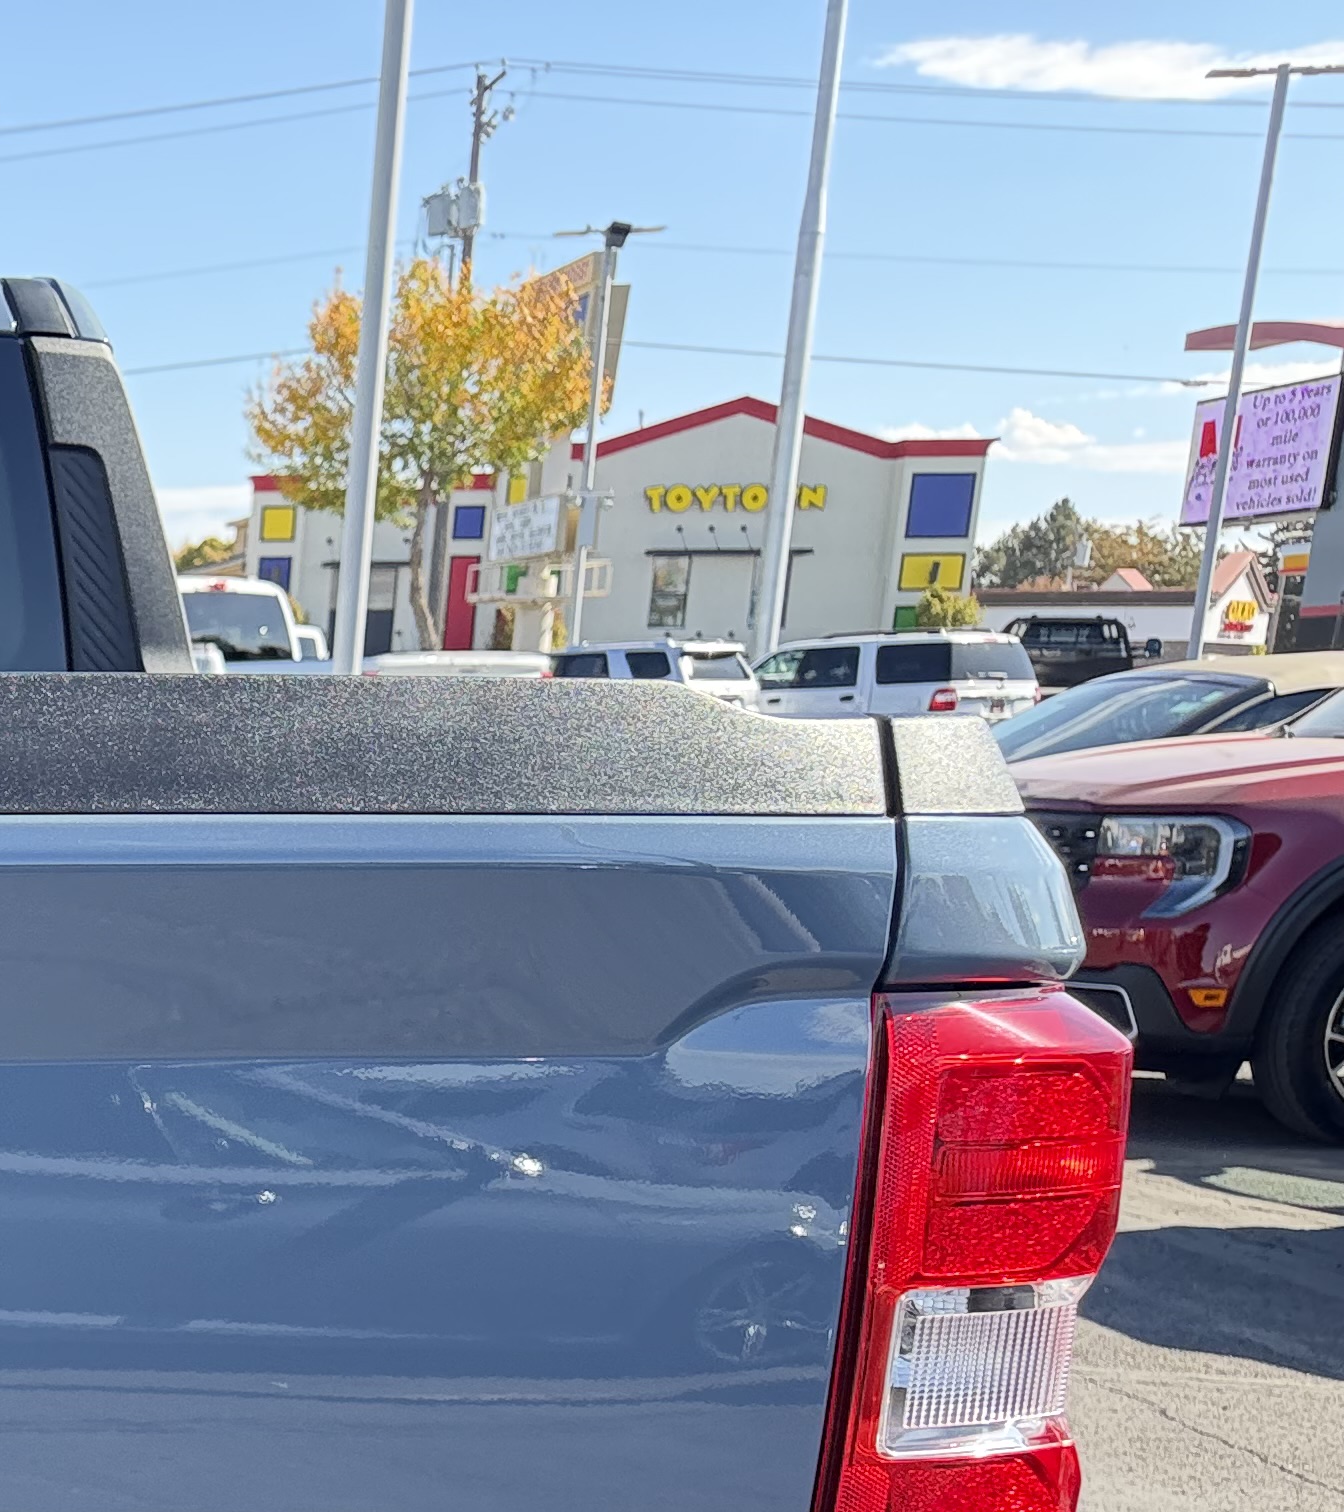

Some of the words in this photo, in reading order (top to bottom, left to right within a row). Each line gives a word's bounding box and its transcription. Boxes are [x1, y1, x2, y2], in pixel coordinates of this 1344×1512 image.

[1253, 395, 1271, 411] Up
[1274, 393, 1286, 406] to
[1271, 429, 1299, 446] mile
[1246, 451, 1299, 470] warranty
[1302, 448, 1318, 462] on
[1248, 475, 1278, 490] most
[1281, 467, 1310, 482] used
[645, 483, 828, 512] TOYTON
[1236, 490, 1282, 511] vehicles
[1285, 486, 1317, 502] sold!
